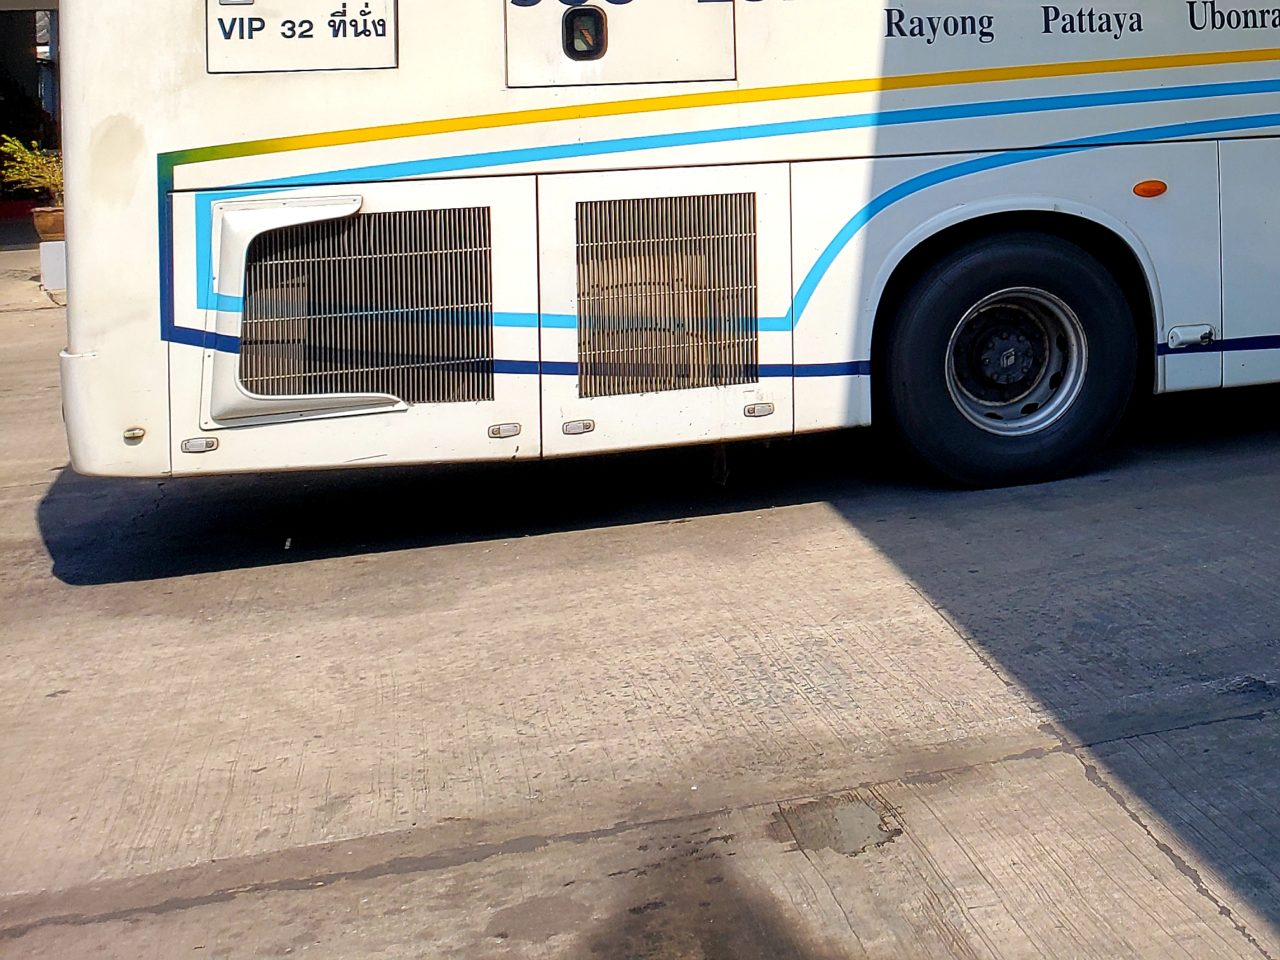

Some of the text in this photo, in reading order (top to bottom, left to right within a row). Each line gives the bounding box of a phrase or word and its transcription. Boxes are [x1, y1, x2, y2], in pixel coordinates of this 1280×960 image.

[217, 2, 387, 40] VIP 32 ที่นั่ง
[884, 8, 995, 44] Rayong
[1041, 5, 1144, 39] Pattaya
